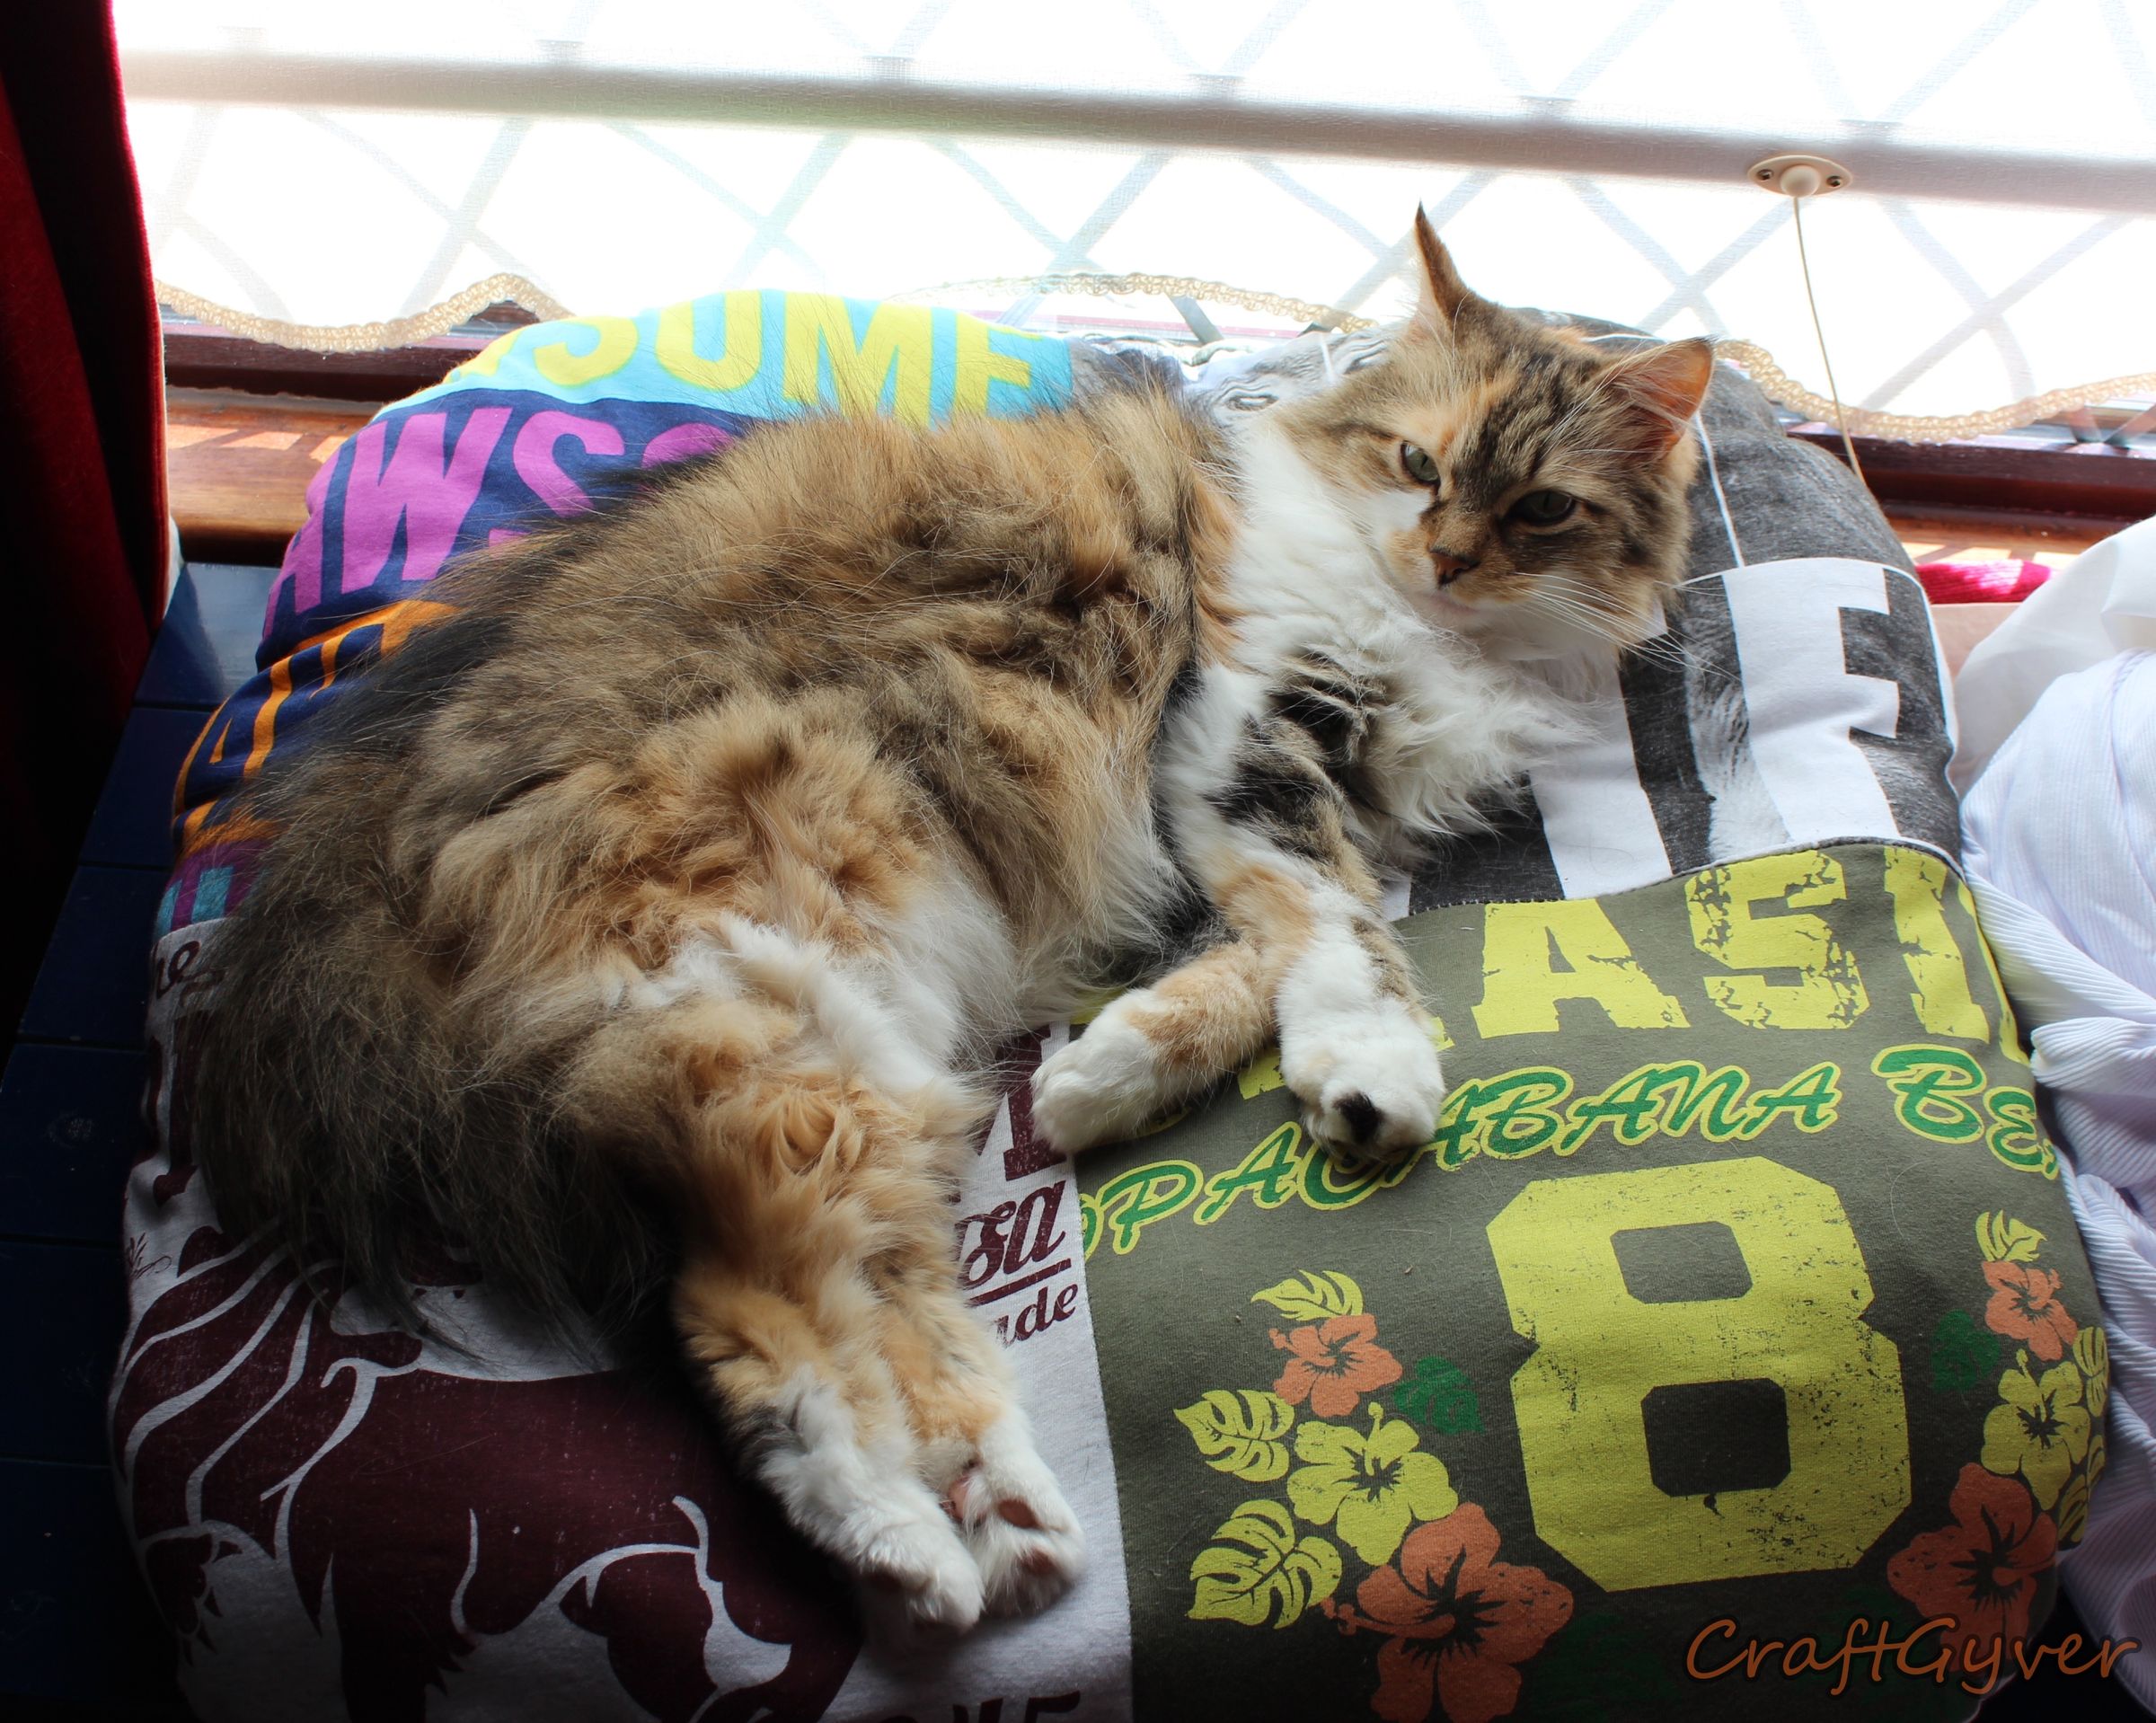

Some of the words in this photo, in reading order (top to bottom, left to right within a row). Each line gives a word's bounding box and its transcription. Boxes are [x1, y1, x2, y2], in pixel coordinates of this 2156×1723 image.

[452, 288, 1049, 431] SOME
[1870, 1043, 2059, 1180] BE
[1485, 1155, 1913, 1592] 8
